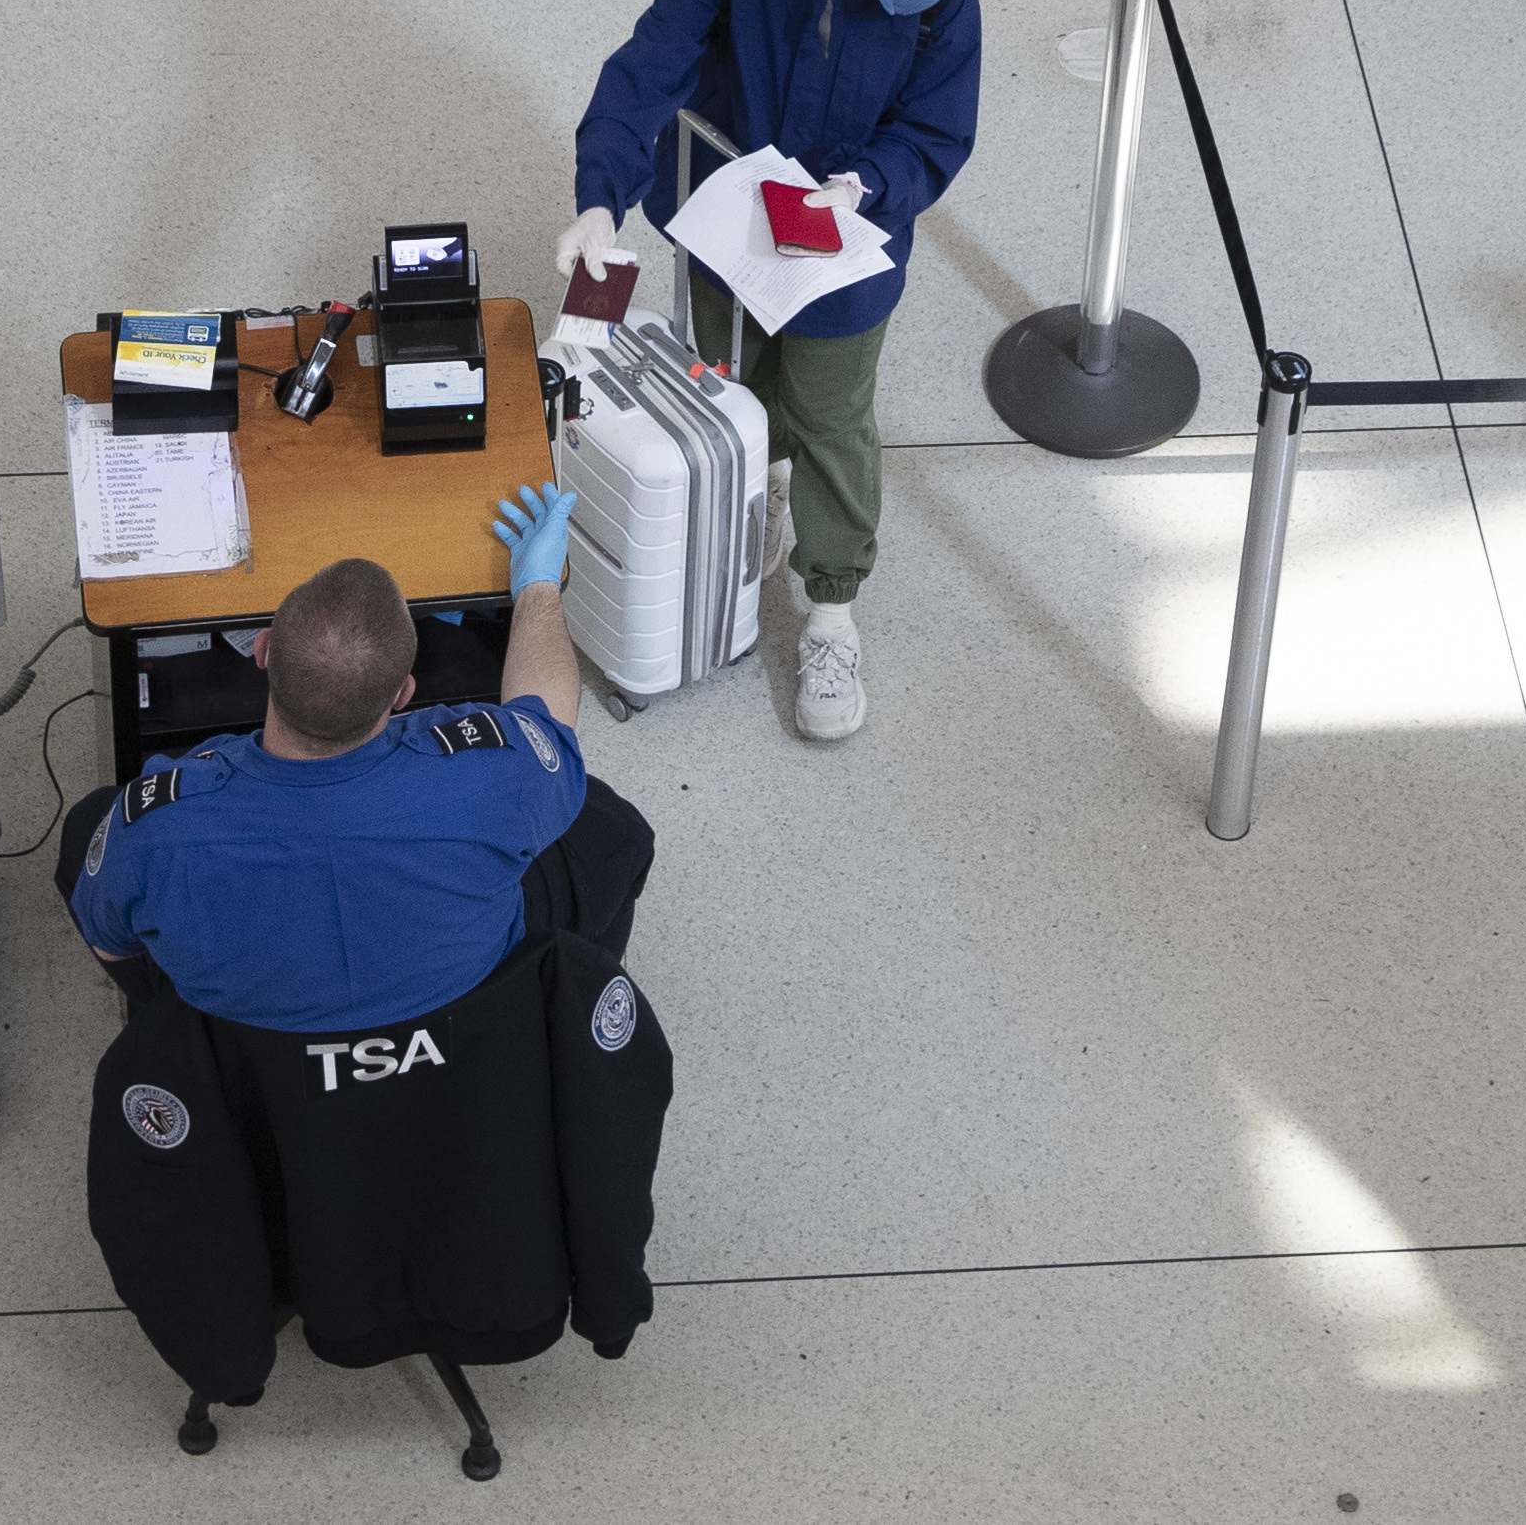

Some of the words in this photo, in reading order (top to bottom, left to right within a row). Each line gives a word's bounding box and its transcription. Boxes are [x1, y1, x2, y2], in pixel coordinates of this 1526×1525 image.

[142, 350, 153, 358] ID
[155, 351, 177, 361] Your
[178, 353, 207, 364] Check
[115, 525, 156, 533] LUFTHANSA
[117, 540, 159, 548] NORWEGIAN
[197, 639, 208, 649] M
[456, 717, 482, 746] TSA
[141, 774, 158, 809] TSA
[306, 1029, 446, 1092] TSA
